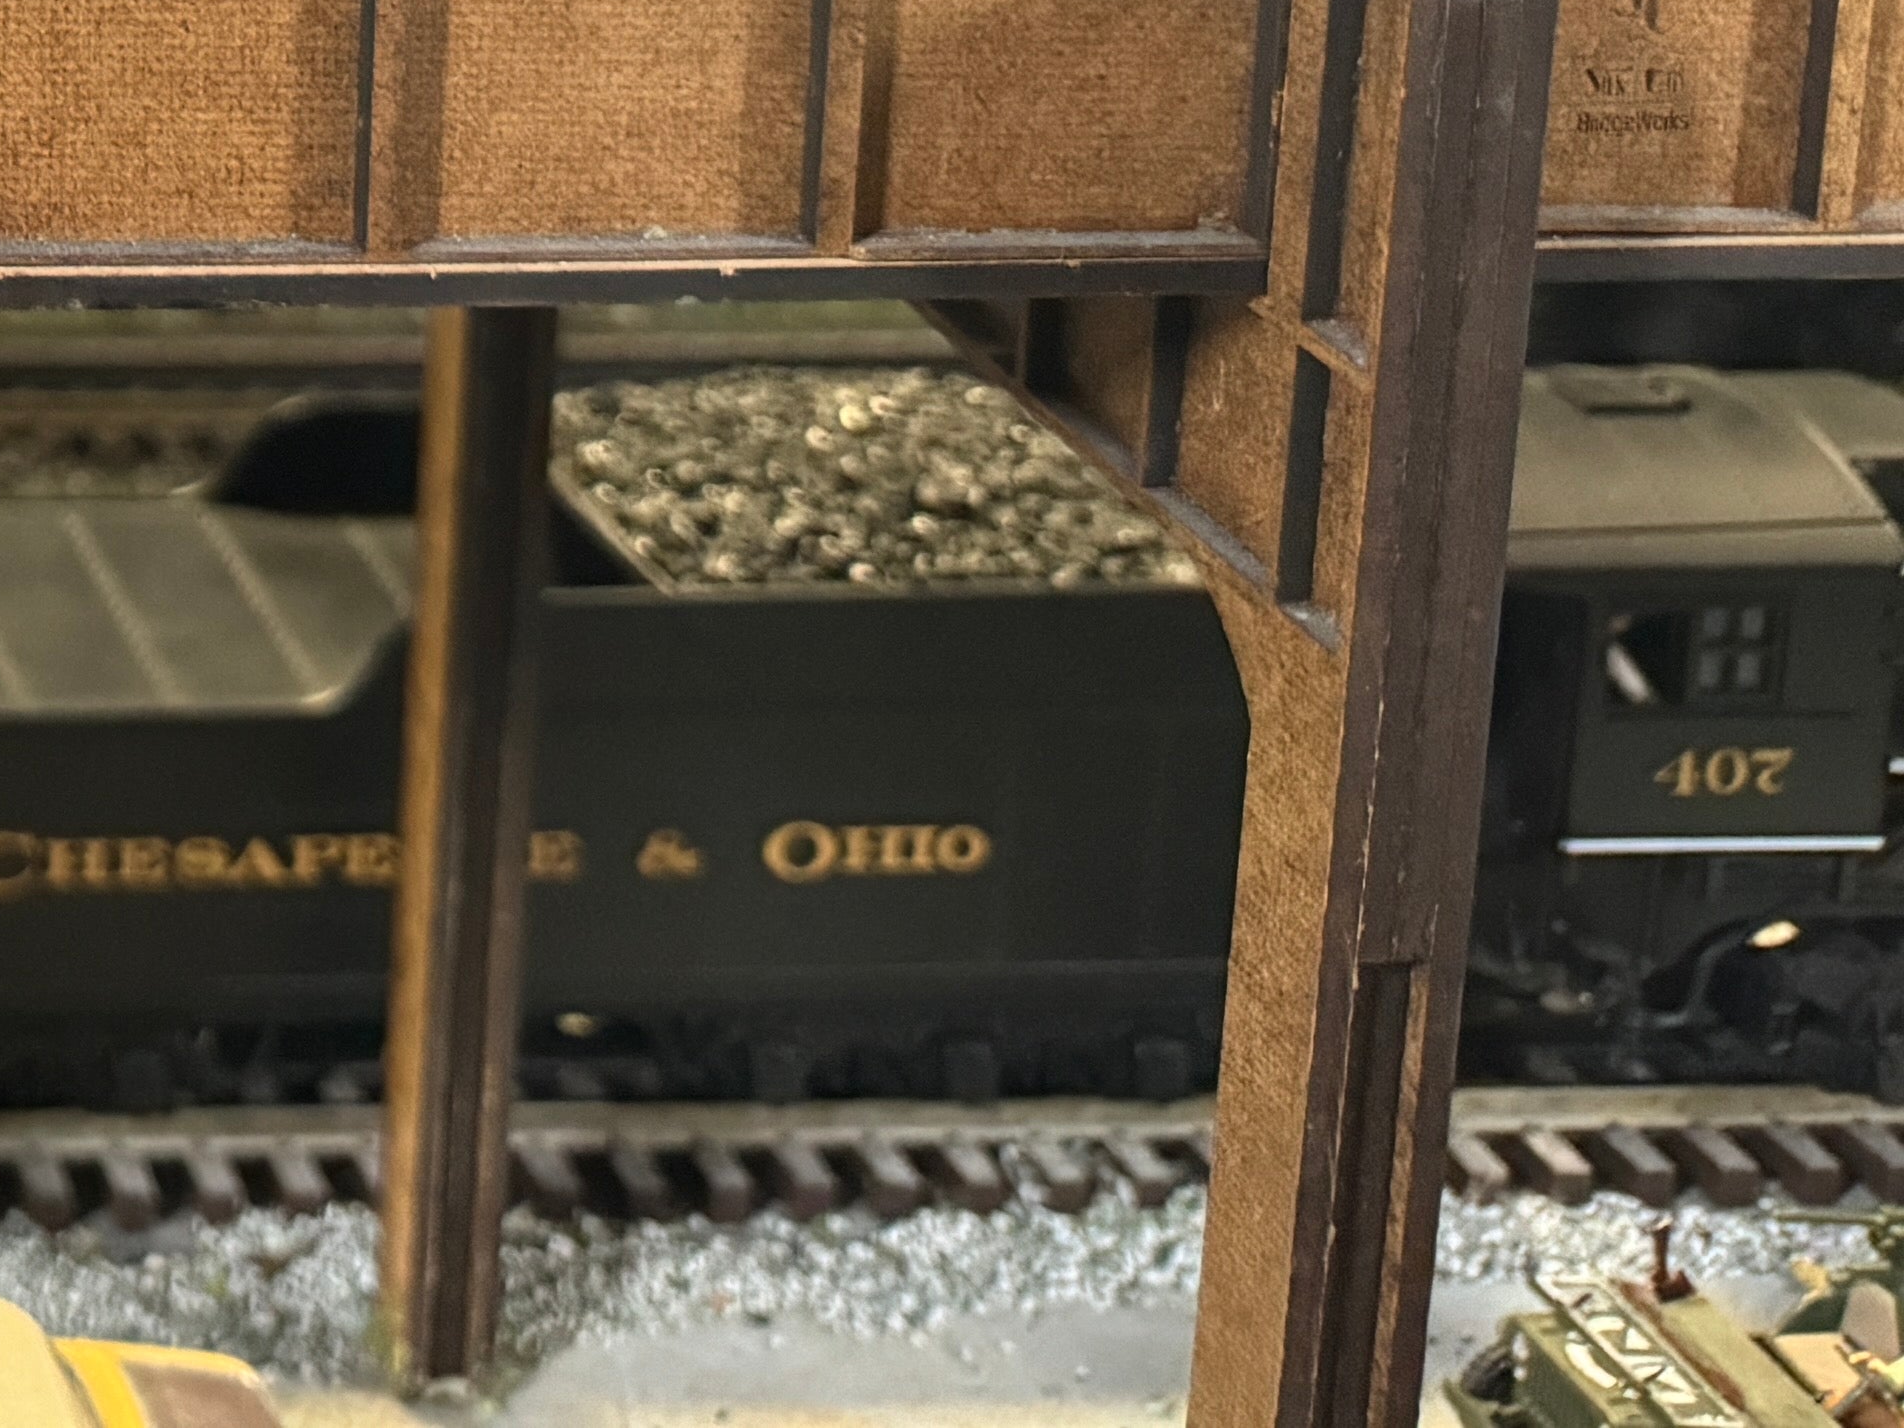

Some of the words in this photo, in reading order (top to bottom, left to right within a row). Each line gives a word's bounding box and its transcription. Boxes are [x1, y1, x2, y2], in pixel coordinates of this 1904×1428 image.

[1653, 747, 1795, 798] 407
[636, 828, 706, 881] &
[762, 818, 991, 885] OHIO
